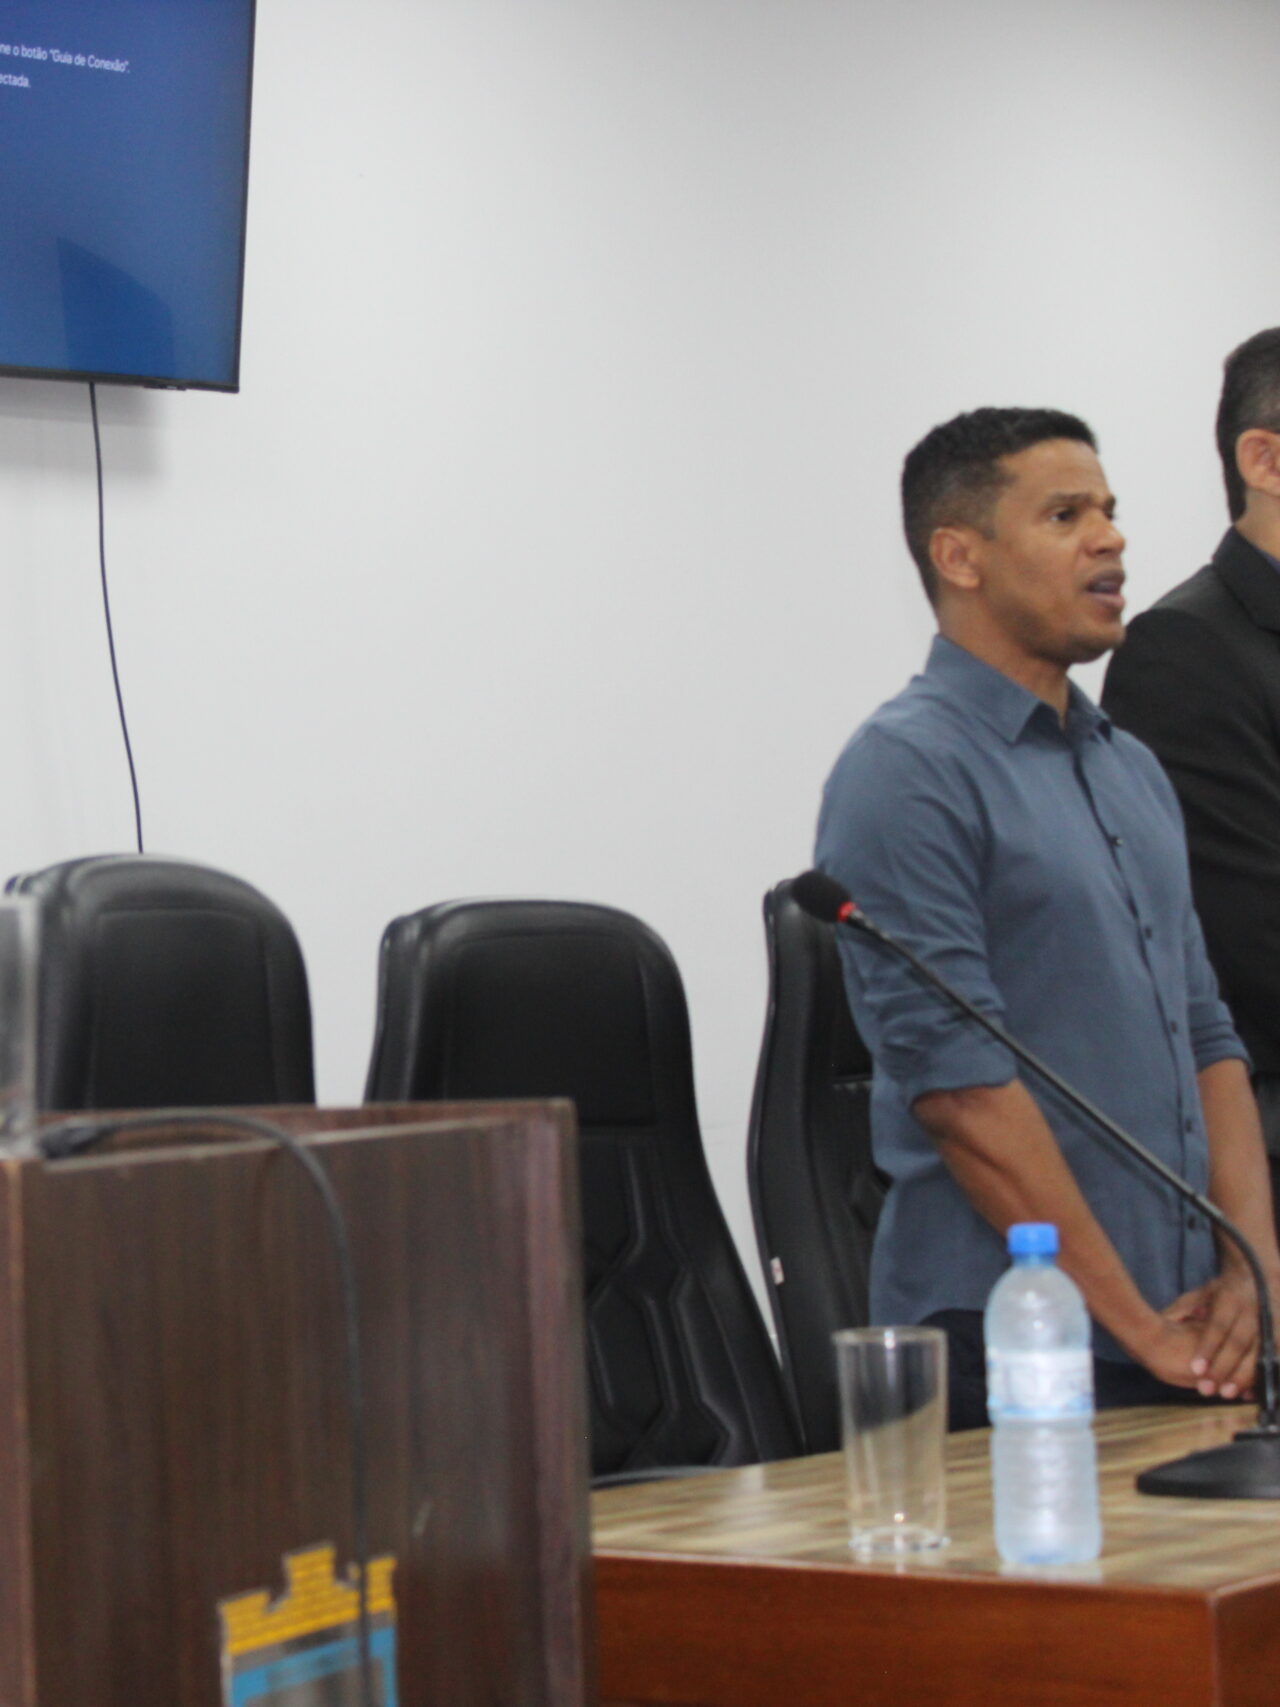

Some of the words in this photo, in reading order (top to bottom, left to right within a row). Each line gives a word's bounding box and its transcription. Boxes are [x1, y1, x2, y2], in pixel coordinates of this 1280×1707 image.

[12, 46, 20, 56] o
[21, 44, 48, 60] botão
[49, 49, 73, 64] "Guia
[74, 53, 86, 66] de
